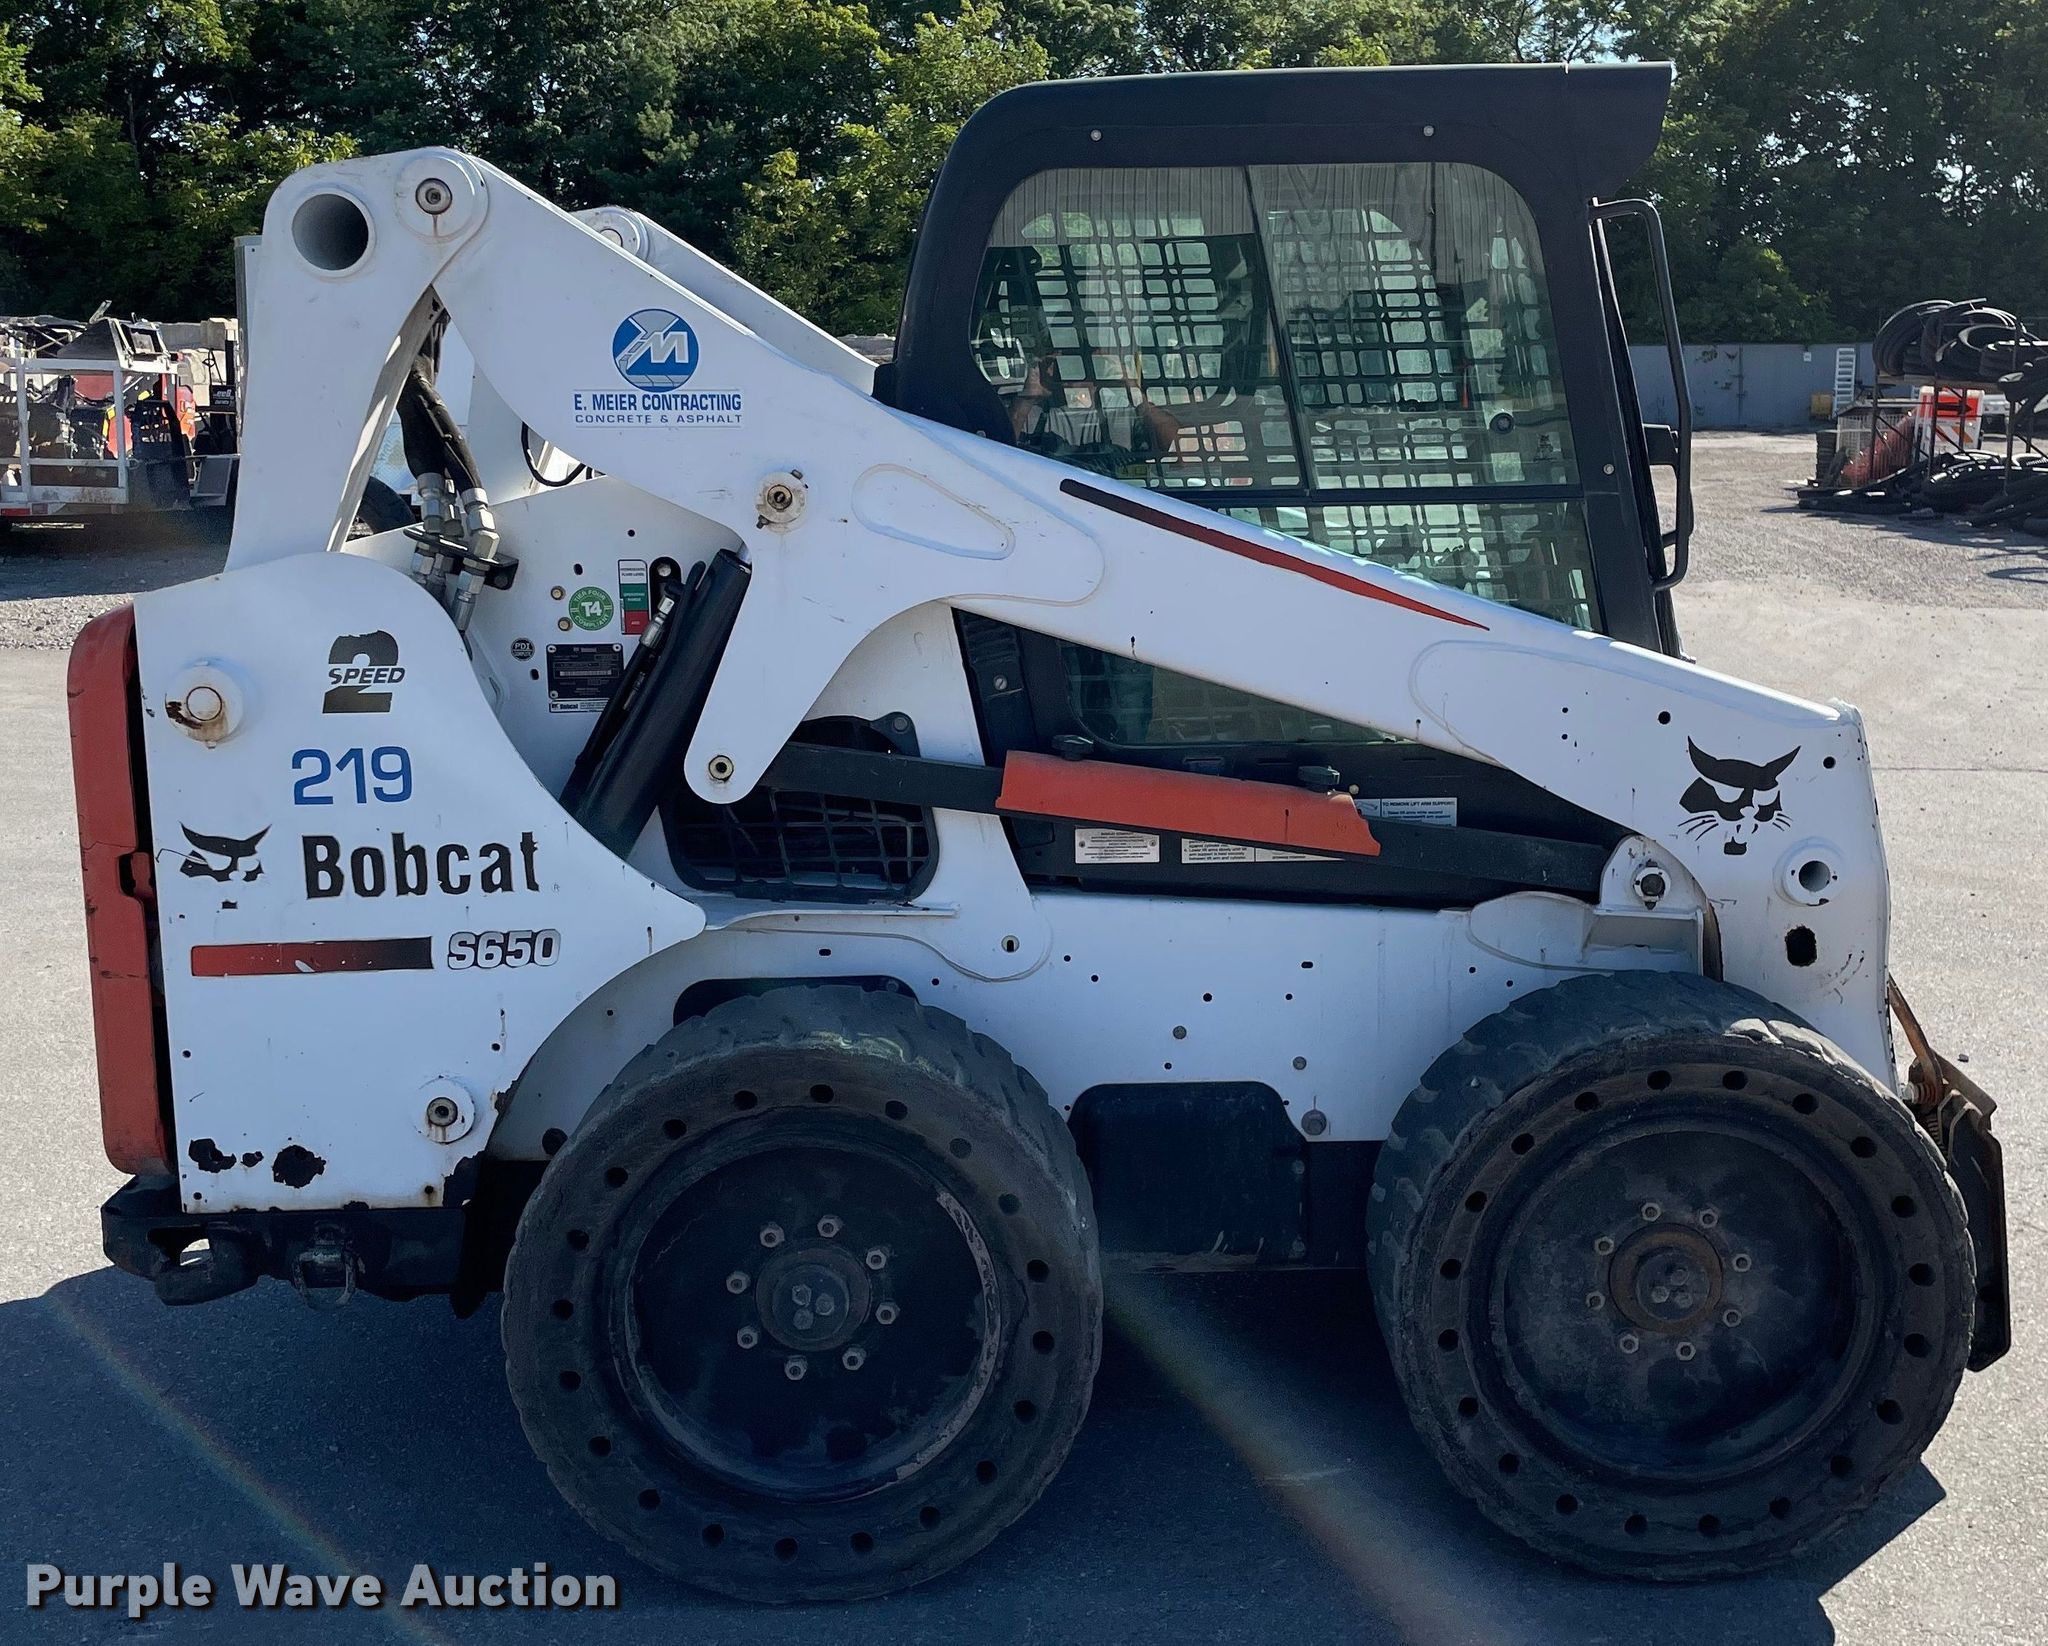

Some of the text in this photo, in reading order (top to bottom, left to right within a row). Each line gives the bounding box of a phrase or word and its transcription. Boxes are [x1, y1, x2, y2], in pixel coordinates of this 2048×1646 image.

[574, 393, 742, 411] E. MEIER CONTRACTING
[575, 414, 742, 424] CONCRETE & ASPHALT
[581, 600, 602, 617] T4
[515, 642, 530, 650] PDI
[328, 666, 406, 685] SPEED
[291, 746, 413, 805] 219
[301, 832, 540, 900] Bobcat
[447, 929, 562, 971] S650
